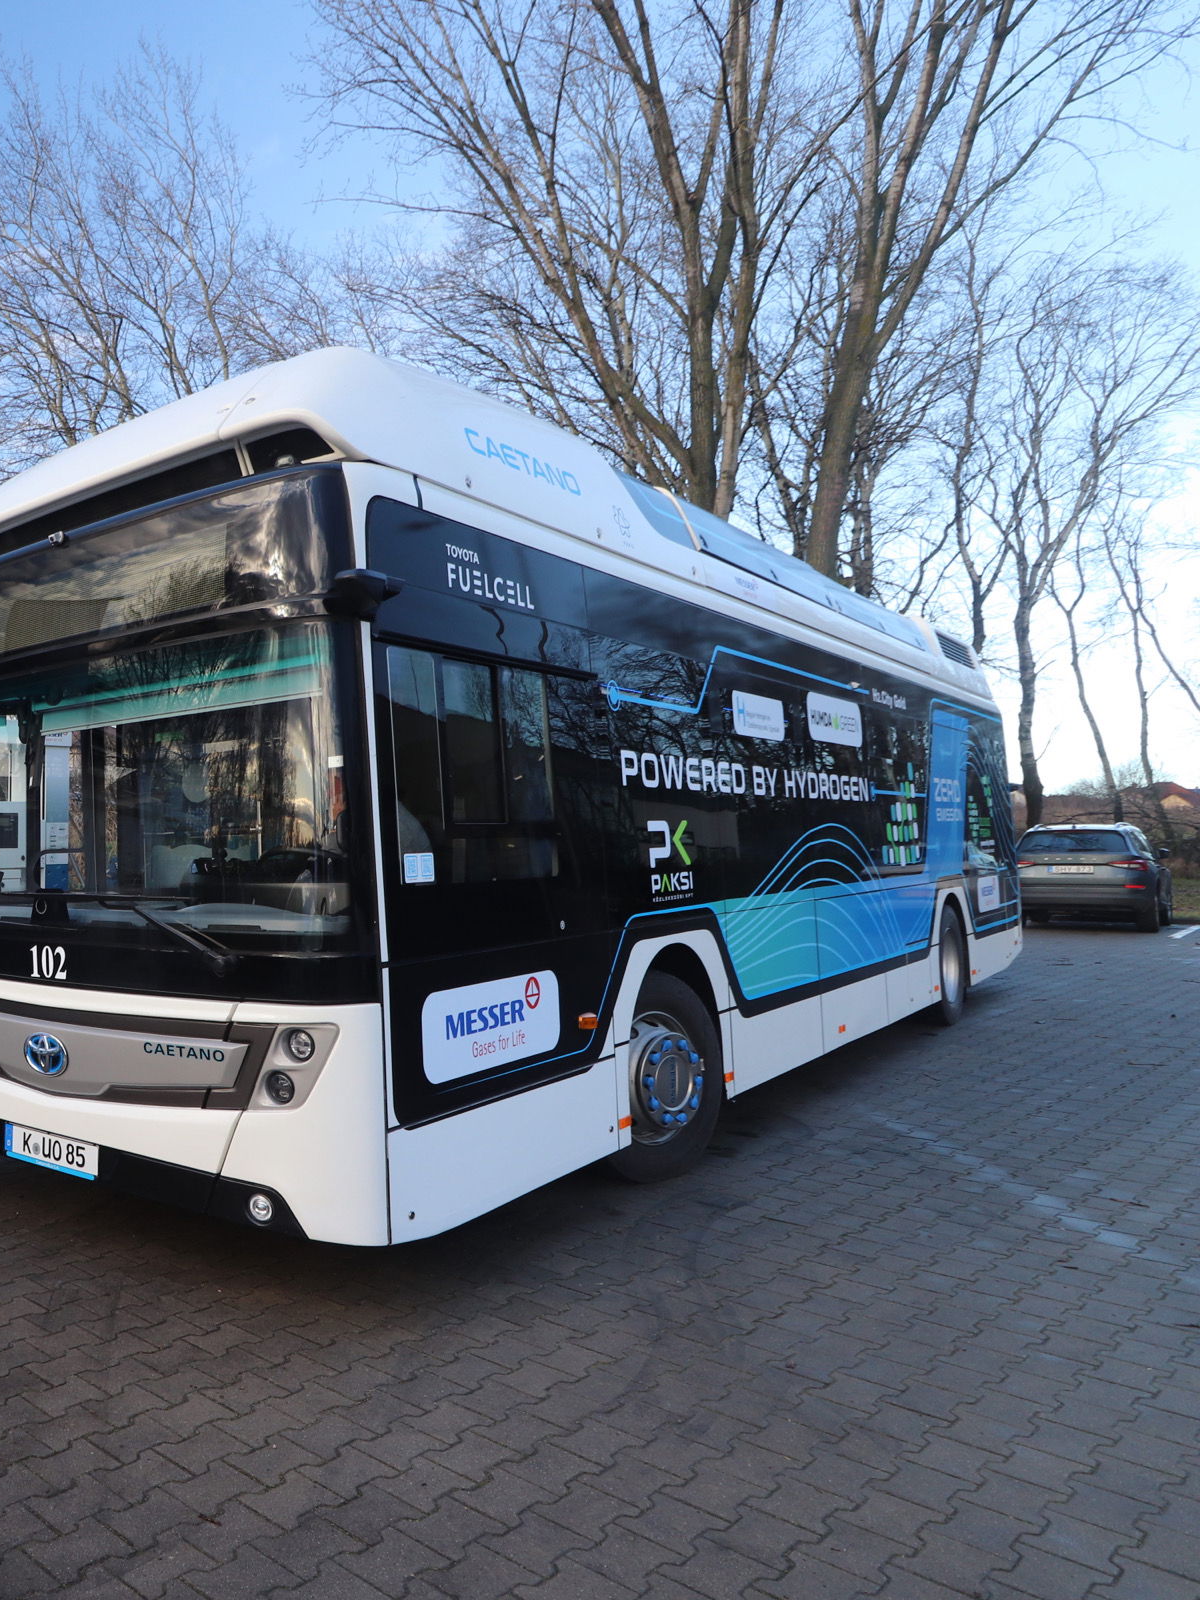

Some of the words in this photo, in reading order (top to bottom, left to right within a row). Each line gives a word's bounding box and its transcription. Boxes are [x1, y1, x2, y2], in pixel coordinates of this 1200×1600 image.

[464, 428, 581, 496] CAETANO
[446, 544, 480, 565] TOYOTA
[447, 563, 535, 610] FUELCELL
[620, 749, 746, 795] POWERED
[752, 765, 777, 797] BY
[783, 769, 869, 802] HYDROGEN
[651, 871, 694, 894] PAKSI
[29, 945, 67, 980] 102
[445, 999, 525, 1041] MESSER
[143, 1042, 225, 1062] CAETANO
[471, 1040, 497, 1058] Gases
[498, 1034, 511, 1051] for
[512, 1030, 526, 1047] Life
[22, 1132, 32, 1154] K
[42, 1136, 62, 1161] UO
[66, 1143, 85, 1168] 85
